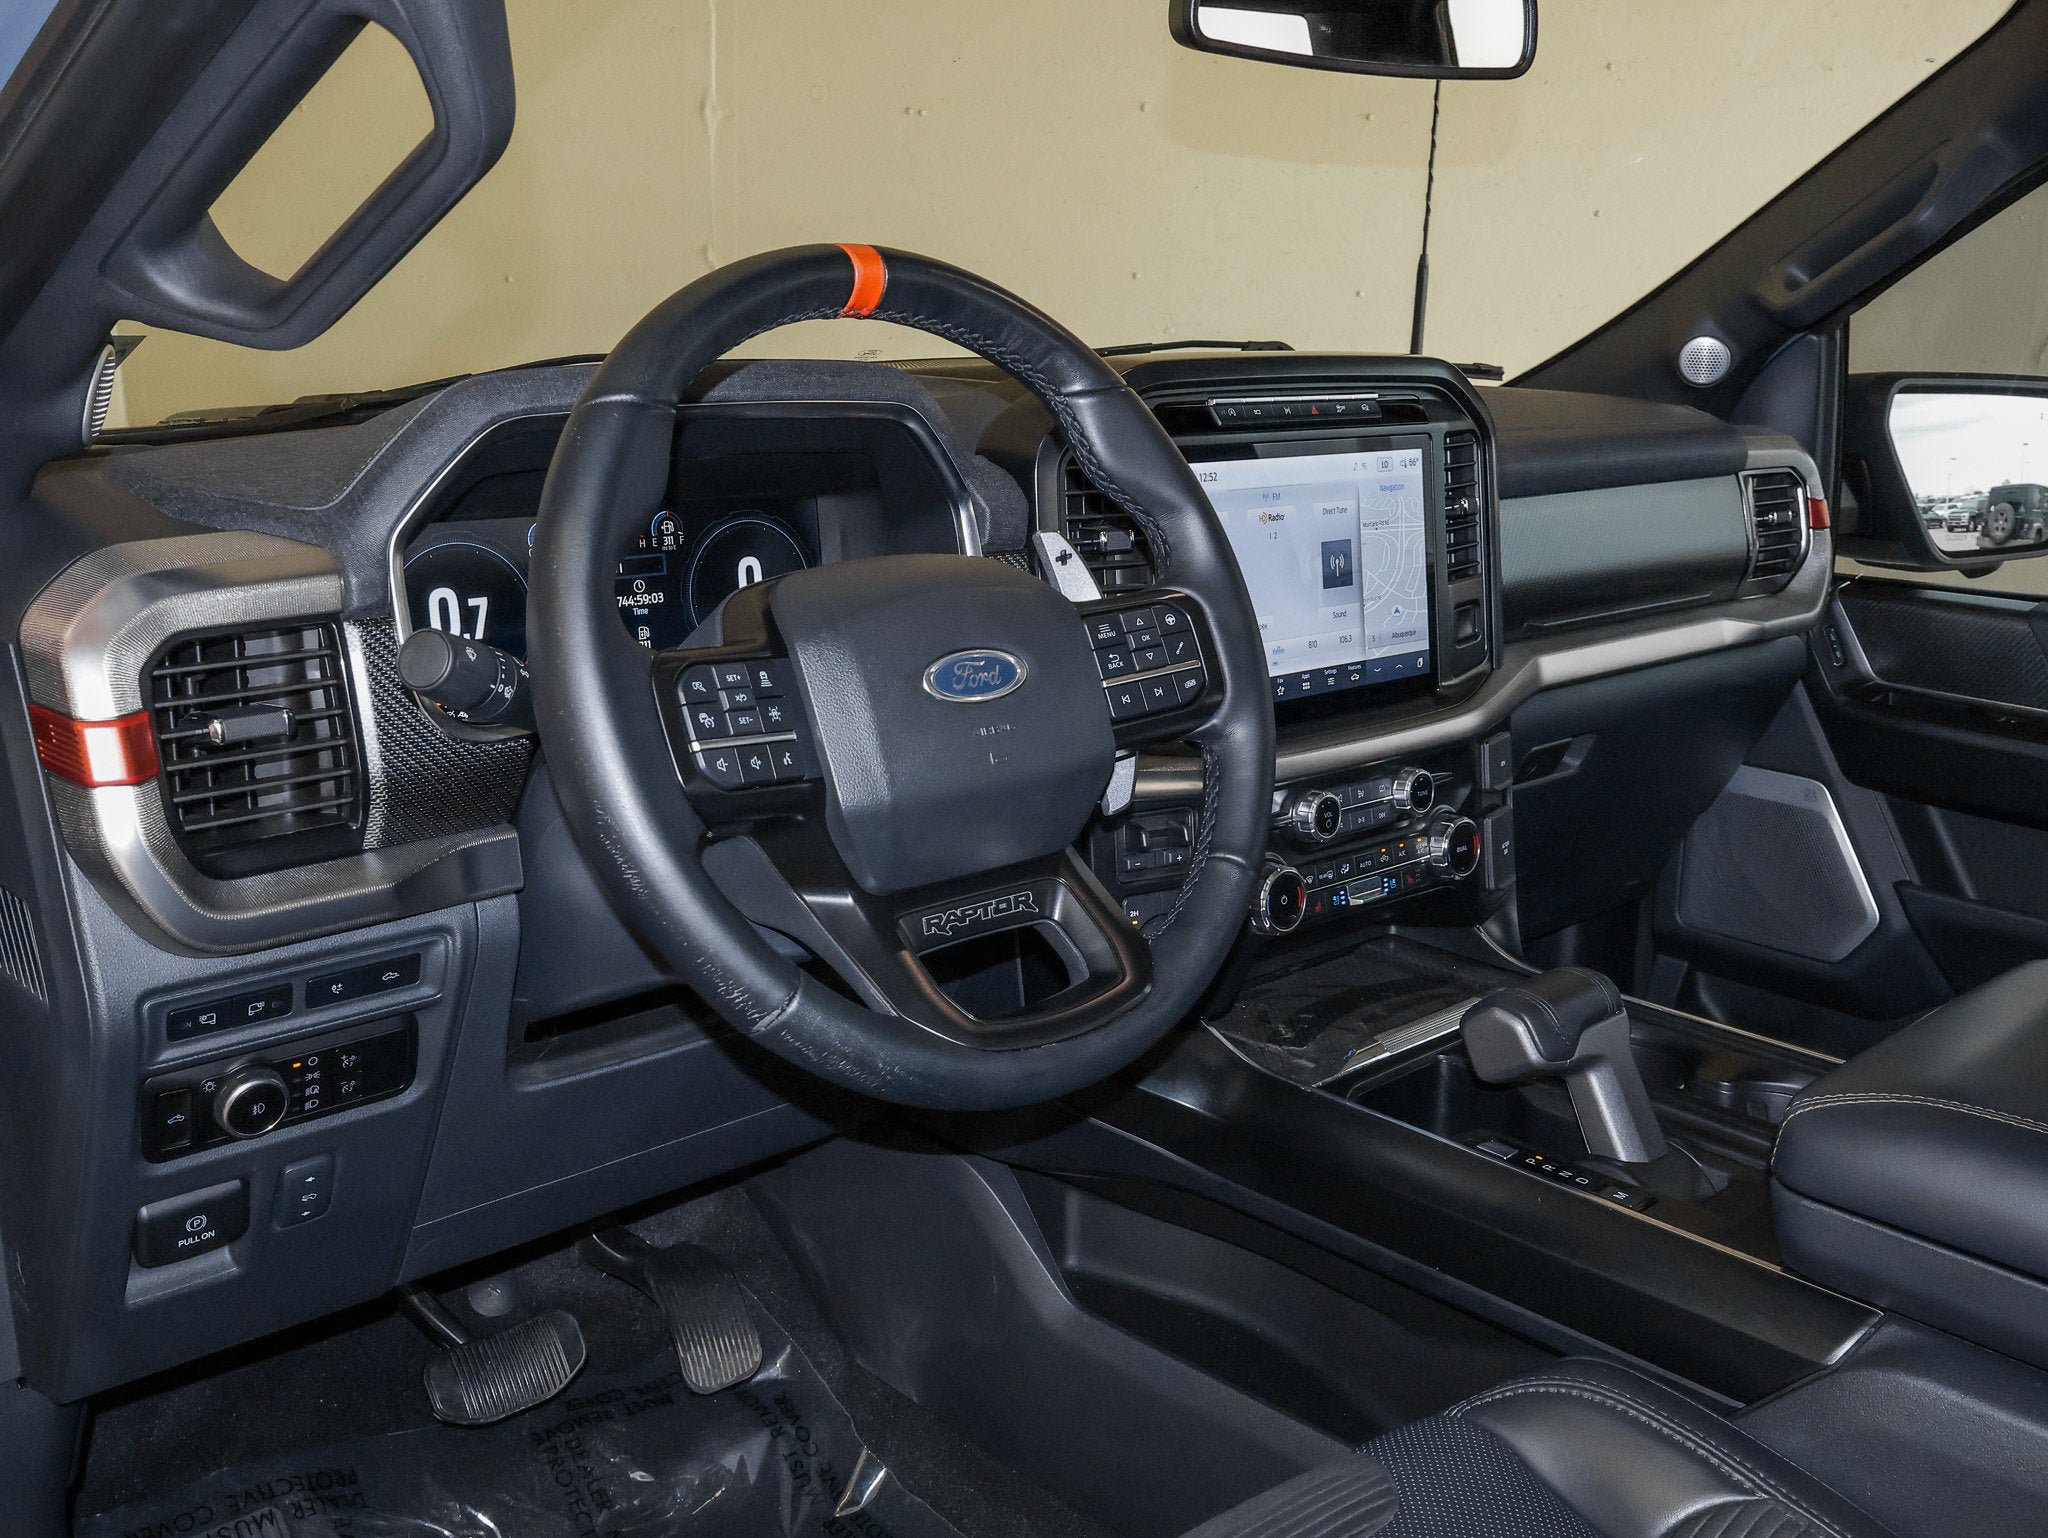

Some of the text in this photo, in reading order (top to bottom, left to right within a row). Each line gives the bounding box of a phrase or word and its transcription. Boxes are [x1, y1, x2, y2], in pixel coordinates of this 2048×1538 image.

[1199, 472, 1218, 482] 12:52
[1379, 483, 1405, 493] Navigation
[1322, 506, 1348, 516] Direct Tune
[1268, 512, 1285, 522] Radio
[639, 539, 646, 548] H
[652, 537, 658, 547] E
[663, 536, 674, 546] 311
[616, 592, 664, 608] 744:59:03
[633, 607, 649, 615] Time
[1332, 610, 1347, 619] Sound
[1098, 631, 1117, 640] MENU
[1391, 628, 1417, 639] Albuquerque
[1107, 661, 1125, 670] BACK
[726, 674, 741, 682] SET+
[952, 659, 1004, 691] Ford
[1456, 845, 1468, 853] DUAL
[1360, 860, 1372, 868] AUTO
[922, 890, 1039, 935] RAPTOR
[1129, 909, 1139, 918] 2H
[1525, 1157, 1538, 1166] P
[1558, 1170, 1574, 1178] N
[1575, 1177, 1590, 1185] D
[1612, 1191, 1629, 1200] M
[178, 1230, 215, 1247] PULL ON
[225, 1468, 358, 1512] PROTECTIVE
